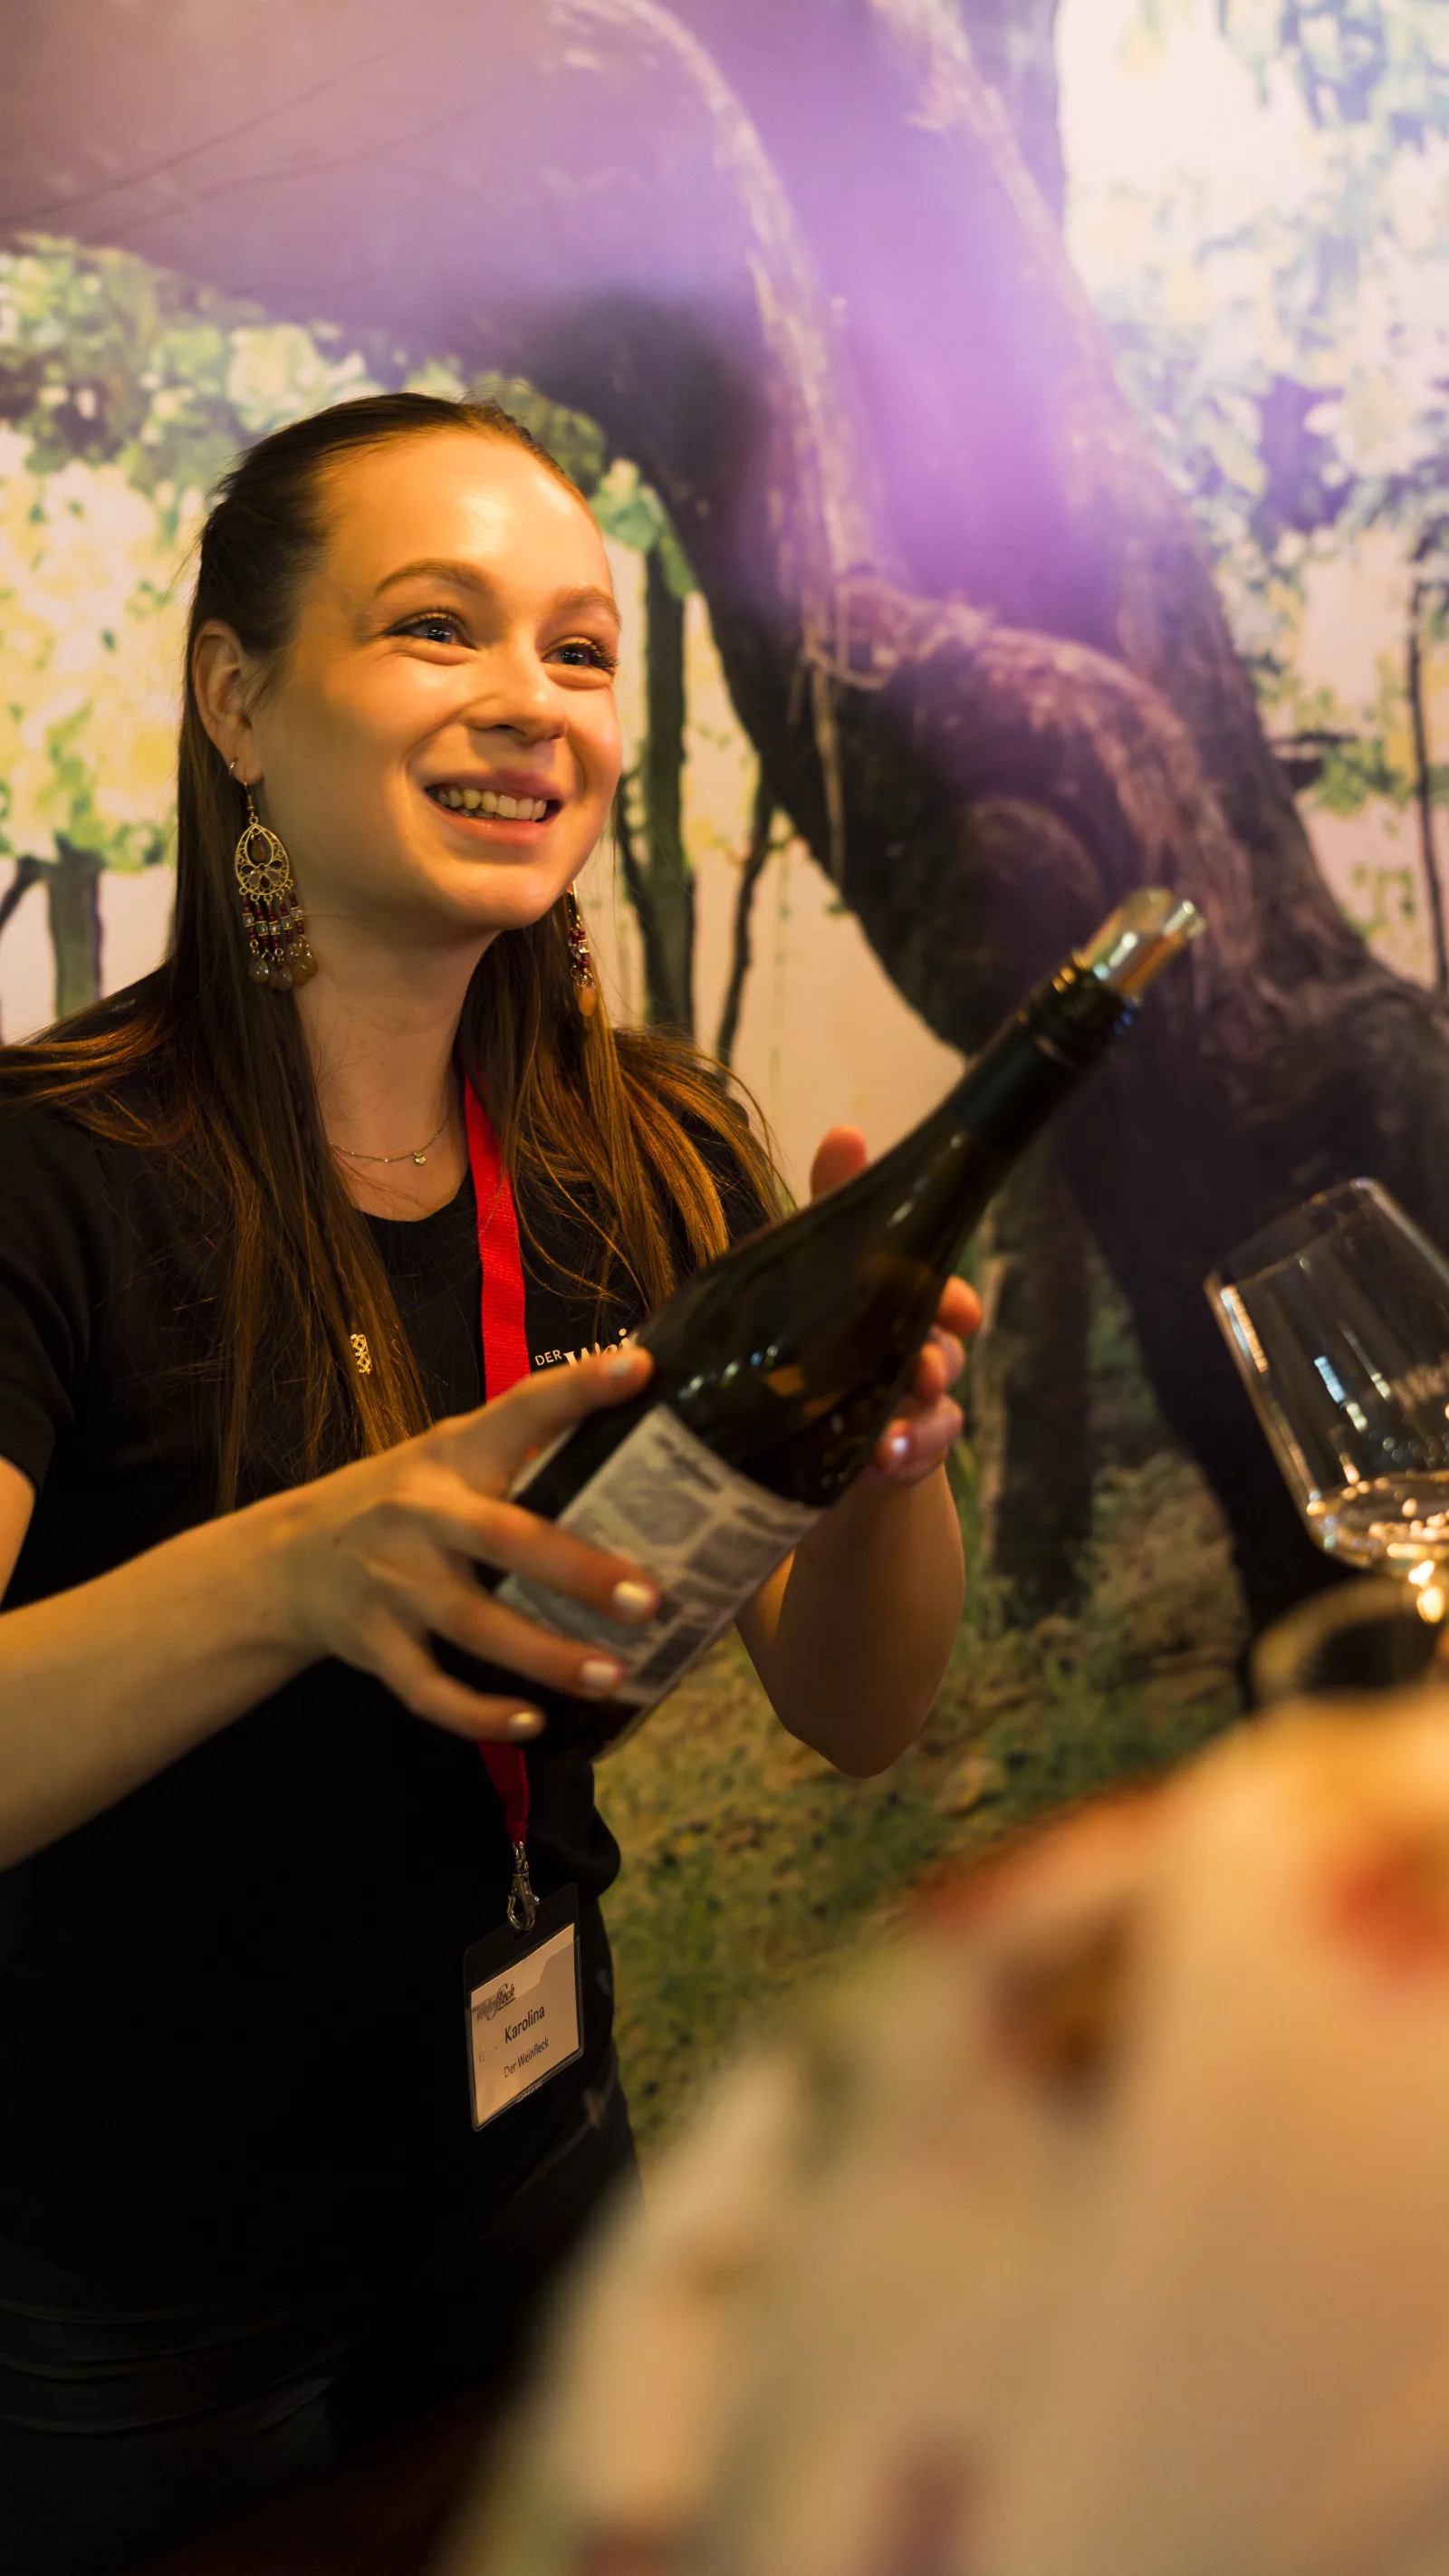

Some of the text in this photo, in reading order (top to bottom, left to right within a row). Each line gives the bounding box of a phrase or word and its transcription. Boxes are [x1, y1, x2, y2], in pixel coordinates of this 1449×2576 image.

[534, 1349, 562, 1366] DER
[504, 2006, 545, 2043] Karolina
[504, 2036, 549, 2078] Der Weinfleck
